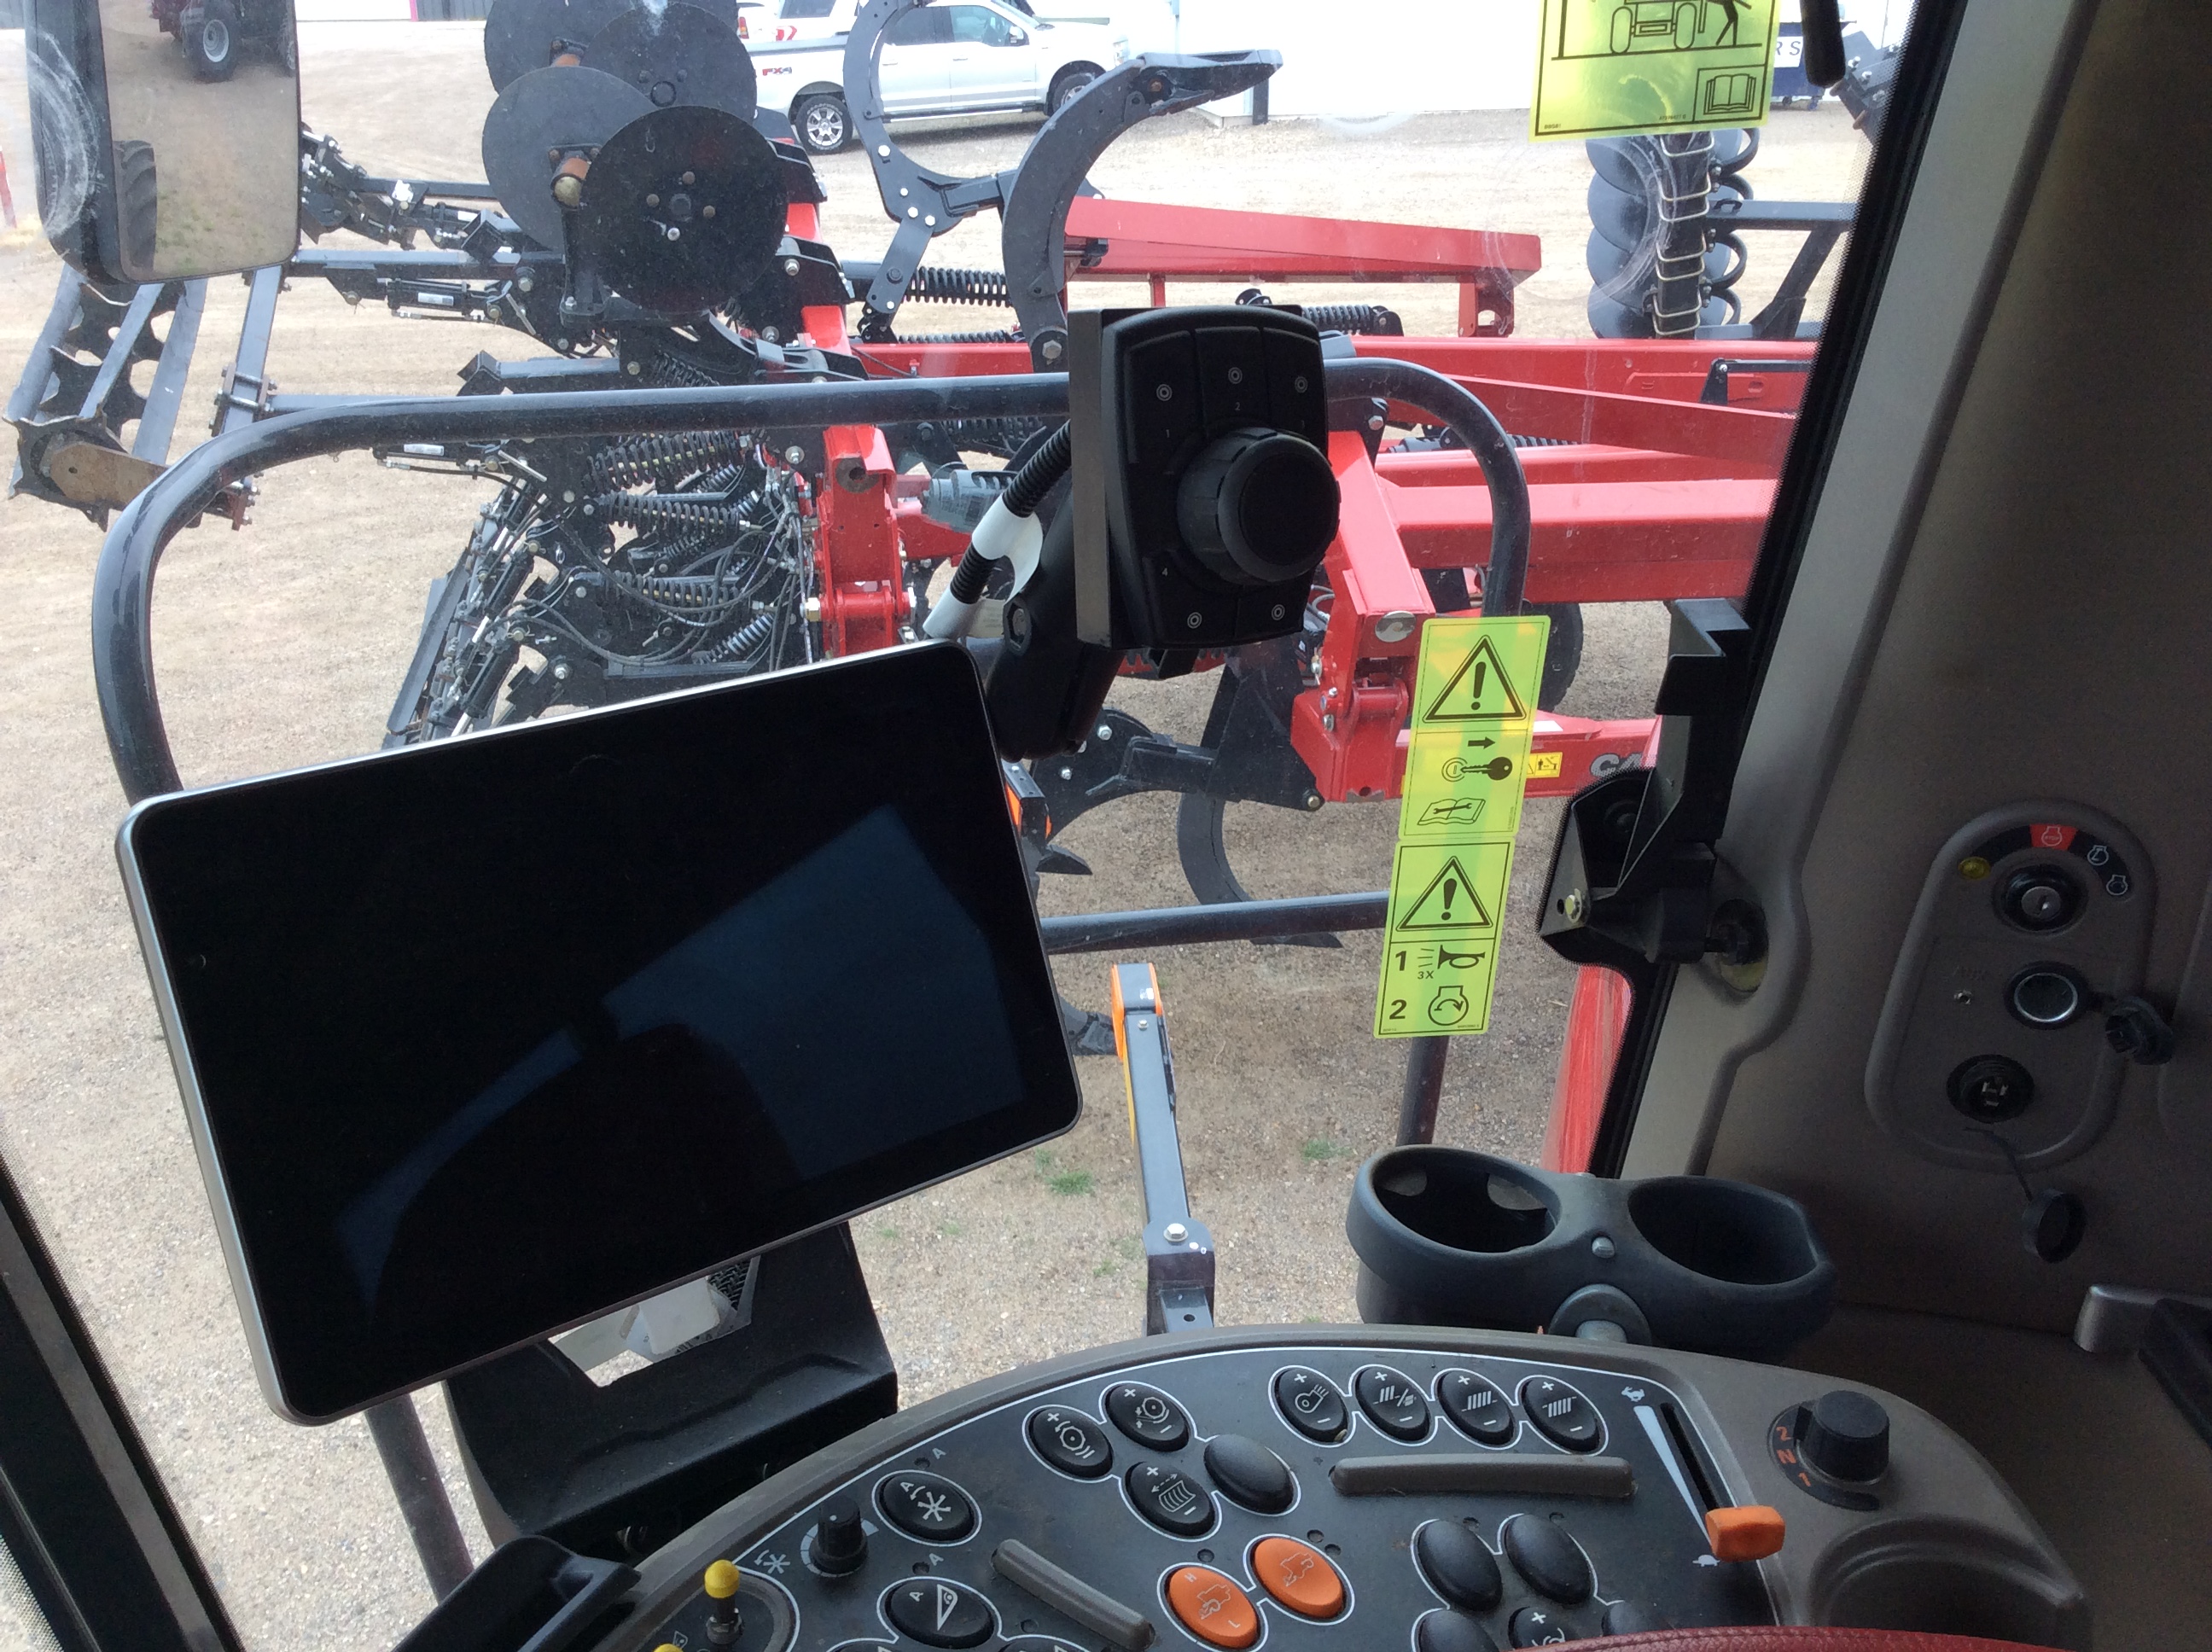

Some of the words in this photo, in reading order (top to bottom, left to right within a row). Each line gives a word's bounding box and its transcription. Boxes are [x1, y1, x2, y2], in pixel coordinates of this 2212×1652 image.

[1234, 401, 1242, 411] 2
[1161, 567, 1169, 578] 4
[1394, 950, 1407, 972] 1
[1417, 969, 1435, 980] 3X
[1388, 998, 1408, 1021] 2
[1775, 1425, 1794, 1442] 2
[931, 1446, 947, 1460] A
[1776, 1448, 1797, 1465] N
[1797, 1471, 1812, 1487] 1
[899, 1480, 915, 1493] A
[928, 1552, 945, 1567] A
[1183, 1572, 1197, 1584] H
[908, 1591, 924, 1603] A
[1227, 1619, 1242, 1629] L
